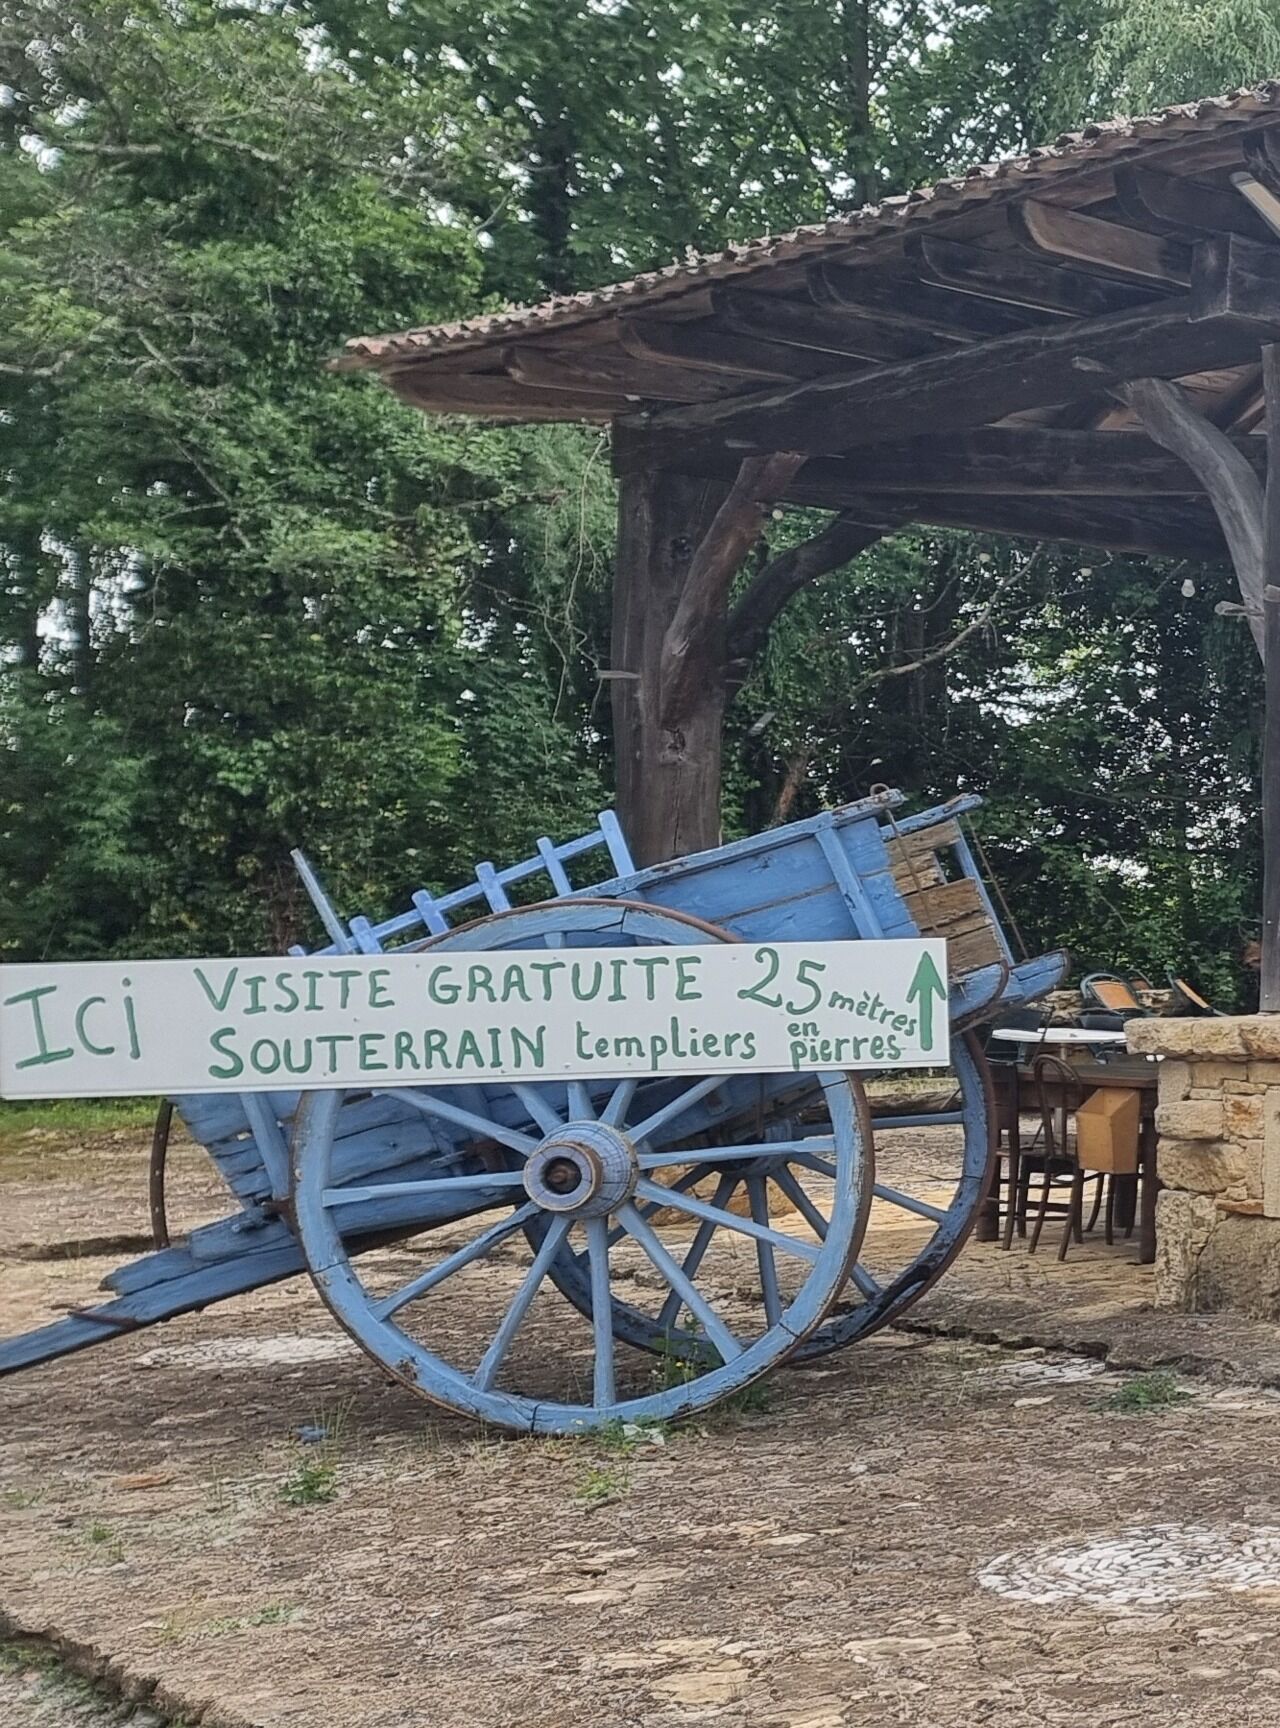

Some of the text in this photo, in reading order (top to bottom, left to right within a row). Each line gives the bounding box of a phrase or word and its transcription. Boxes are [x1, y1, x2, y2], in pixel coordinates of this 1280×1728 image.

[5, 978, 141, 1069] Ici
[193, 947, 918, 1037] VISITE GRATUITE 25 mètres
[208, 1016, 756, 1079] SOUTERRAIN templiers
[787, 1021, 820, 1037] en
[790, 1034, 902, 1071] pierres
